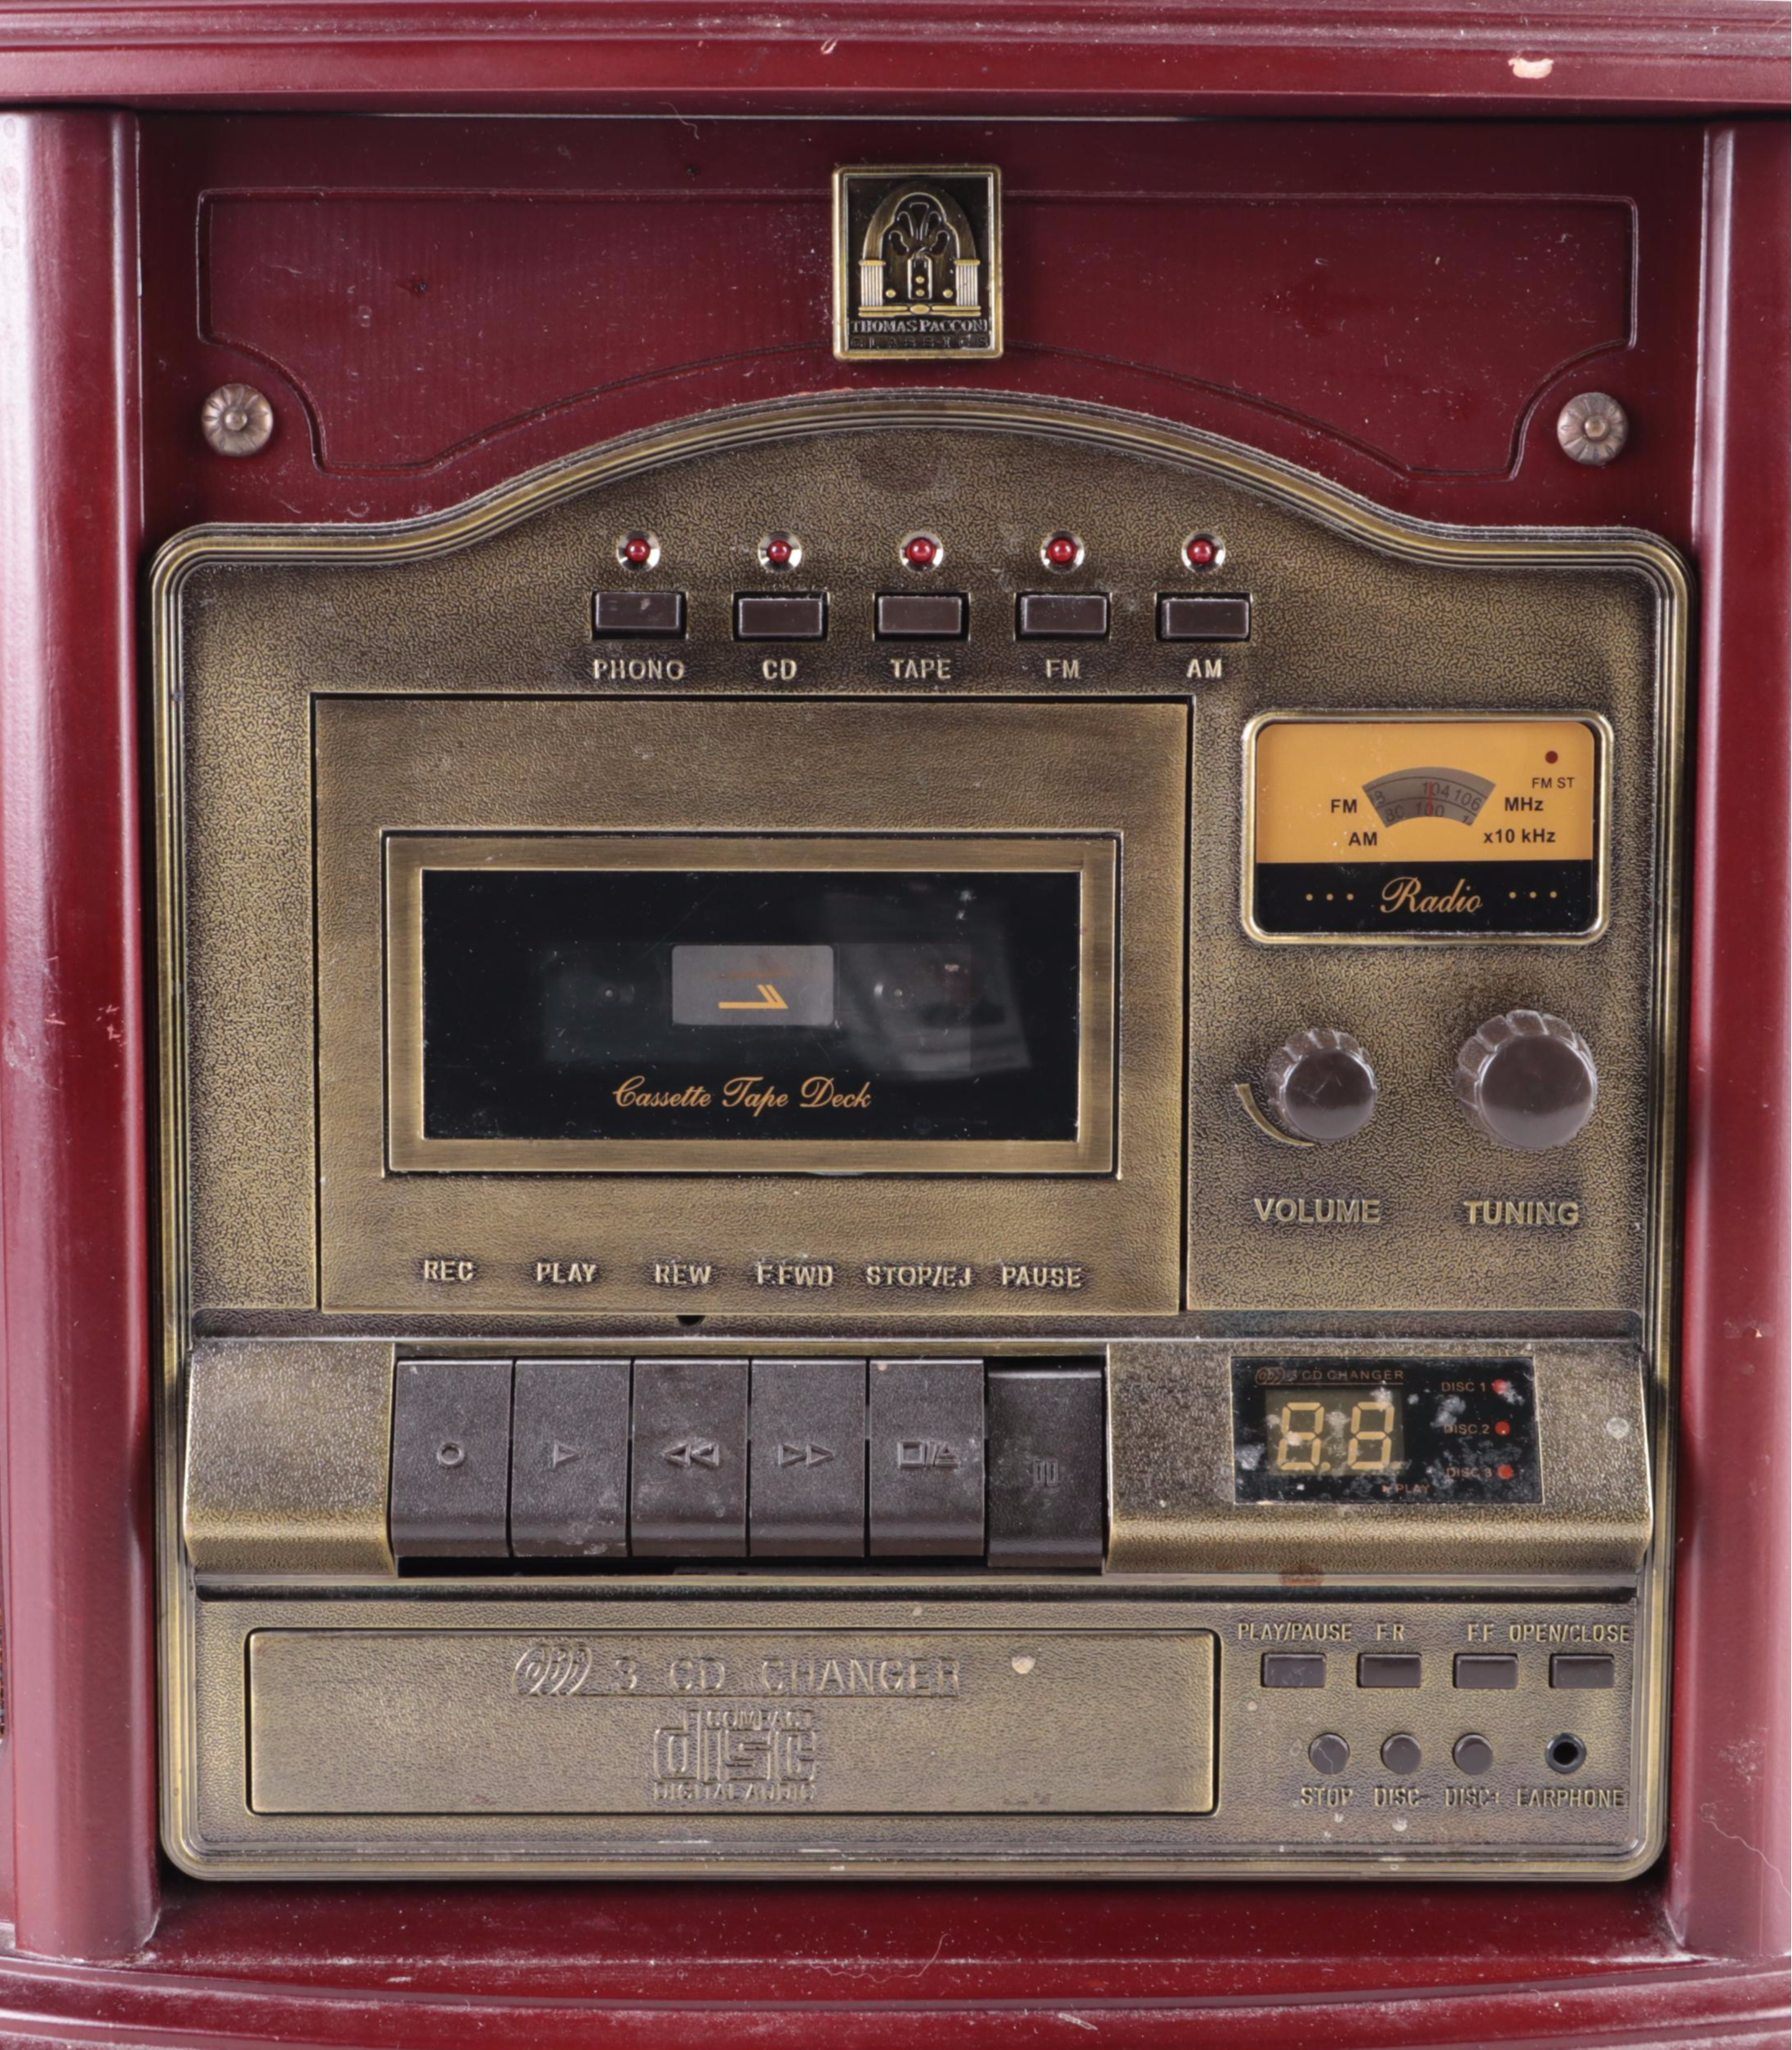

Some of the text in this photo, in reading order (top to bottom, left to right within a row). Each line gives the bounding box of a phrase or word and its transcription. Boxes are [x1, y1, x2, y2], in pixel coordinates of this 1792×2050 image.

[851, 319, 988, 333] THOMAS PACCONI
[593, 658, 686, 680] PHONO
[762, 658, 798, 680] CD
[891, 659, 951, 679] TAPE
[1045, 659, 1080, 679] FM
[1185, 659, 1222, 679] AM
[1532, 776, 1575, 789] FM ST
[1331, 799, 1357, 814] FM
[1455, 789, 1483, 812] 106
[1505, 797, 1544, 812] MHz
[1348, 832, 1378, 847] AM
[1483, 828, 1556, 844] x10 kHz
[1380, 876, 1483, 914] Radio
[612, 1075, 871, 1117] Cassette Tape Deck
[1254, 1198, 1381, 1223] VOLUME
[1464, 1200, 1580, 1225] TUNING
[423, 1259, 474, 1281] REC
[536, 1262, 597, 1284] PLAY
[655, 1263, 712, 1285] REW
[866, 1265, 972, 1287] STOP/EJ
[1002, 1265, 1082, 1287] PAUSE
[1302, 1370, 1323, 1380] CD
[1327, 1370, 1404, 1381] CHANGER
[1441, 1381, 1487, 1392] DISC 1
[1443, 1424, 1490, 1434] DISC 2
[1446, 1468, 1493, 1479] DISC 3
[1395, 1483, 1430, 1493] PLAY
[1238, 1622, 1353, 1642] PLAY/PAUSE
[1510, 1623, 1631, 1643] OPEN/CLOSE
[615, 1657, 959, 1695] 3 CD CHANGER
[654, 1782, 735, 1800] DIGITAL
[1301, 1786, 1354, 1807] STOP
[1517, 1787, 1625, 1808] EARPHONE
